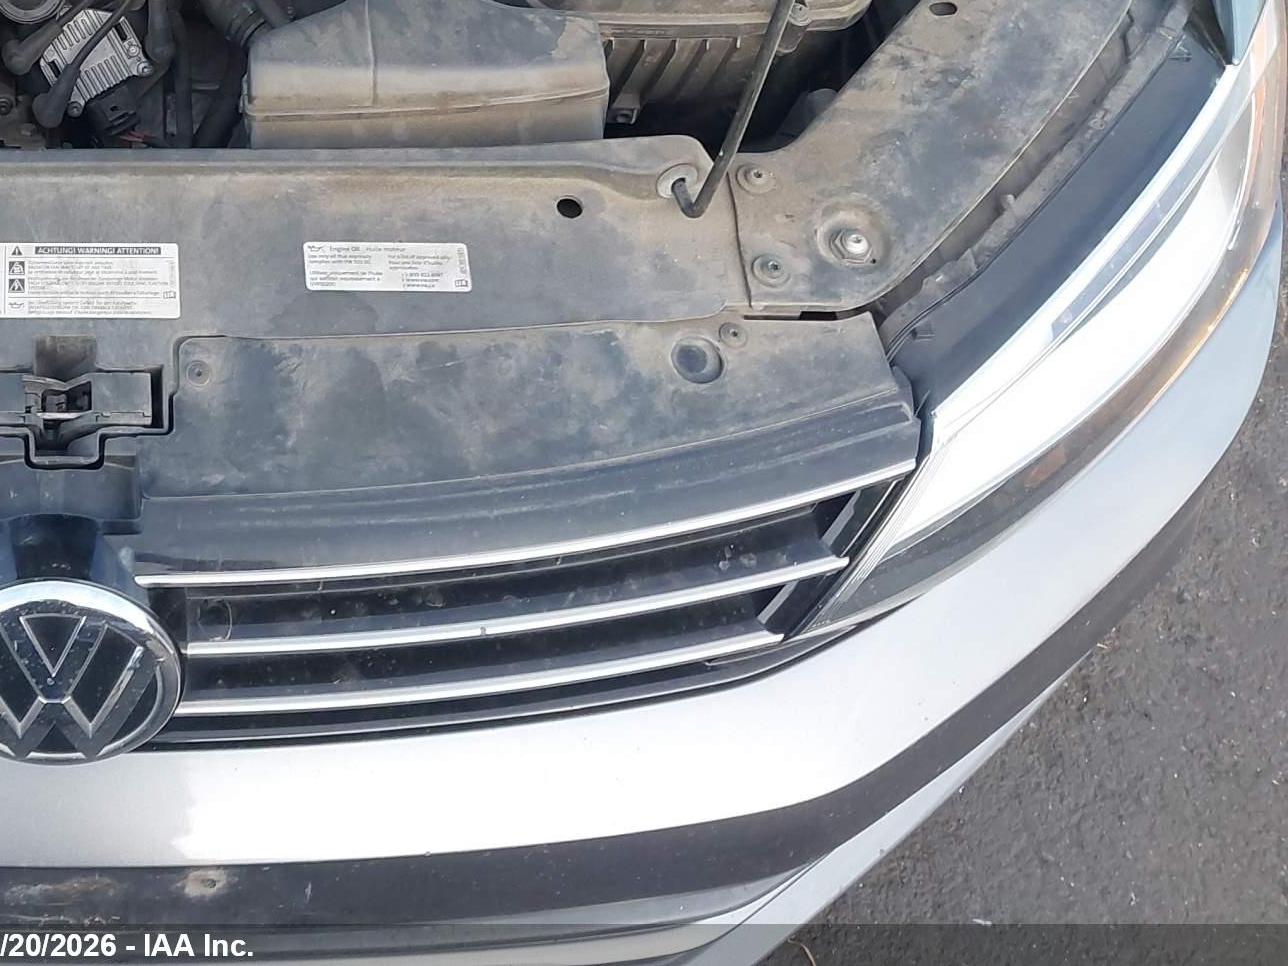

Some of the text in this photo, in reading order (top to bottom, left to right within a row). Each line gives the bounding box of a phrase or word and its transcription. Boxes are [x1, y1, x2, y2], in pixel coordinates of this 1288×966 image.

[37, 246, 159, 255] ACHTUNG! WARNING! ATTENTION!
